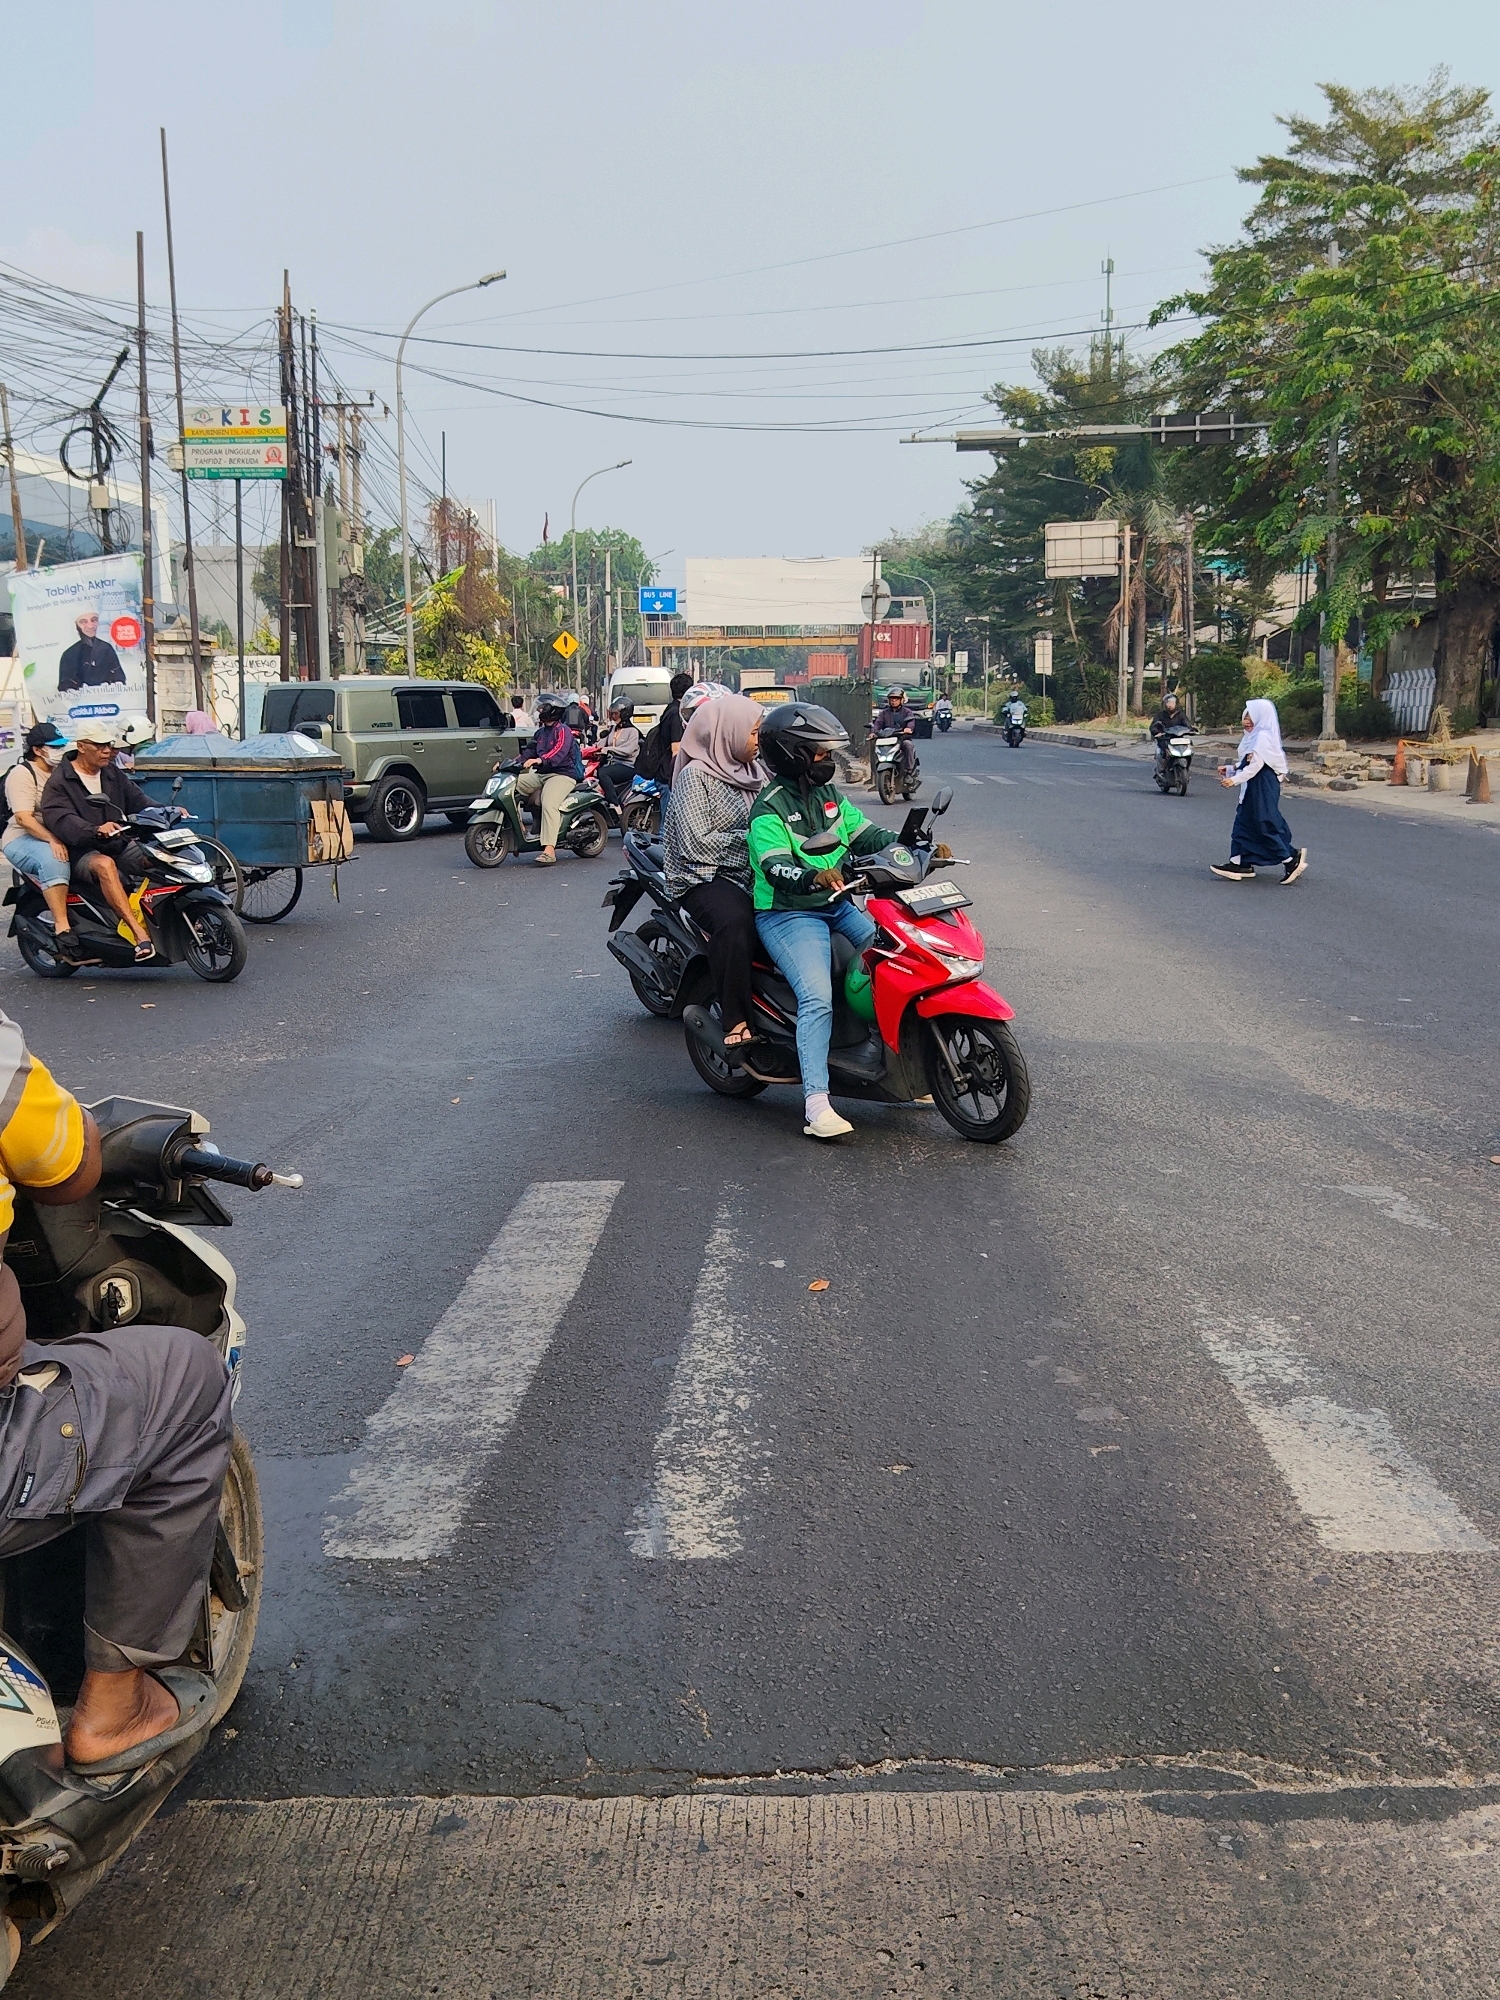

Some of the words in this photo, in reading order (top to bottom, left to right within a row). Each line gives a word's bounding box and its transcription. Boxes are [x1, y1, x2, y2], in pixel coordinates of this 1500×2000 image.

[191, 448, 223, 456] PROGRAM
[224, 448, 261, 456] UNGGULAN
[194, 457, 222, 465] TAHFIDZ
[228, 457, 259, 465] BERKUDA
[45, 582, 84, 598] Tabligh
[643, 591, 656, 599] BUS
[873, 630, 891, 642] tex
[787, 811, 802, 823] rab
[902, 893, 912, 904] B
[913, 886, 938, 900] 5515
